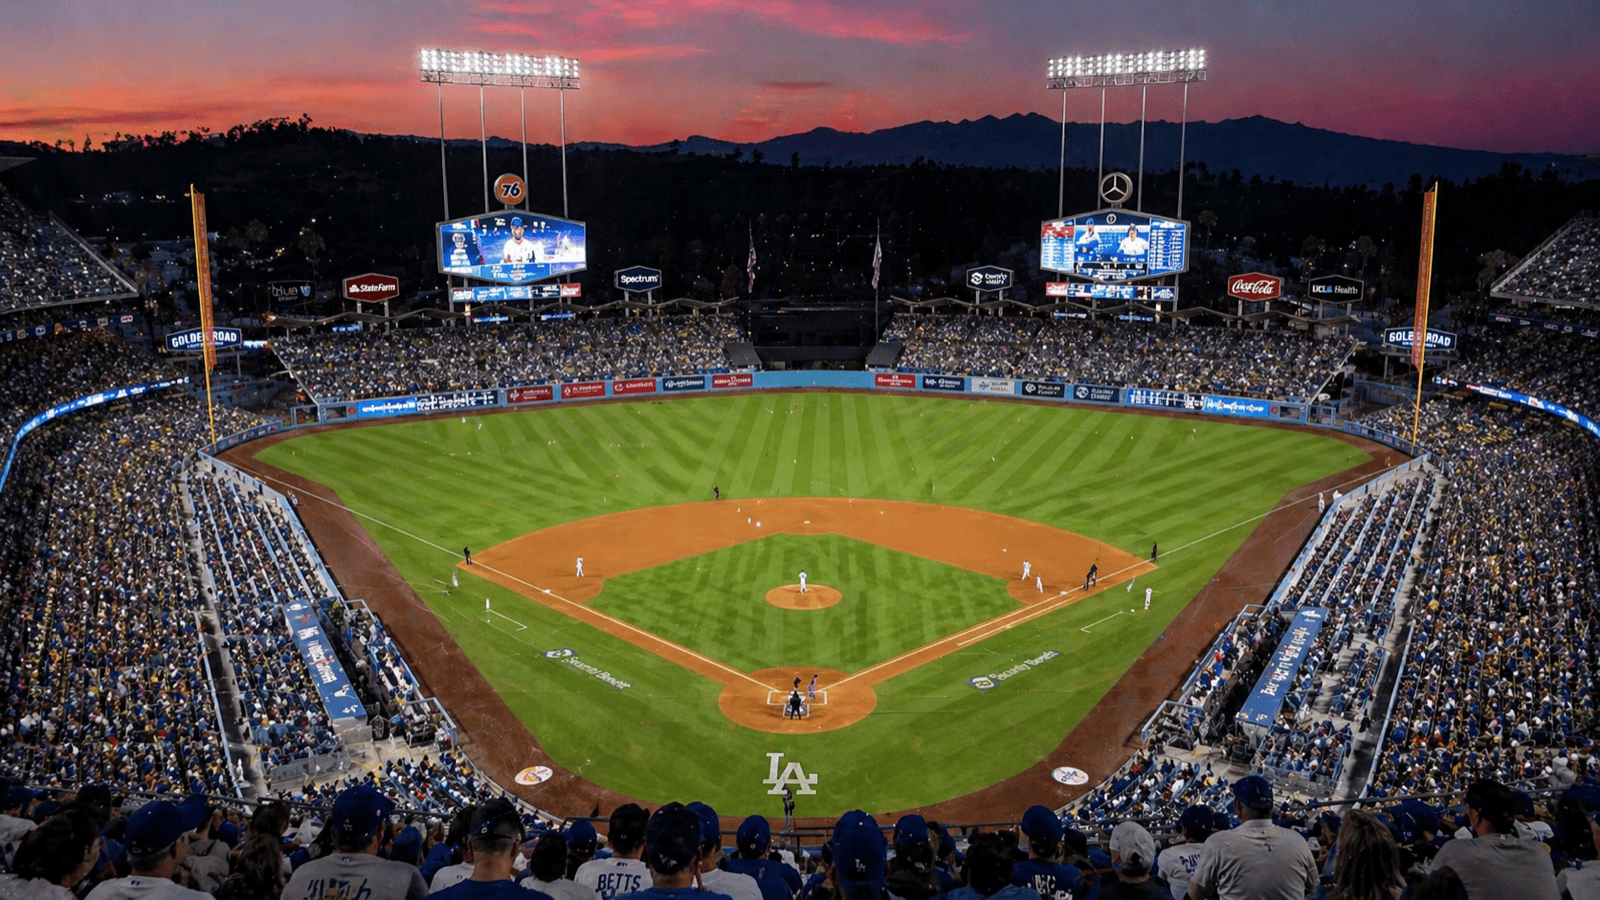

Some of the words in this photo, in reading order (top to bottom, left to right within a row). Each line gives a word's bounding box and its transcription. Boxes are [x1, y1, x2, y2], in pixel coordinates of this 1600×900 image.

[501, 182, 522, 198] 76
[620, 274, 658, 285] Spectrum
[1312, 284, 1333, 293] UCLA
[1334, 284, 1358, 294] Health
[213, 330, 238, 343] ROAD
[1426, 332, 1452, 347] ROAD
[763, 752, 818, 795] LA
[597, 873, 642, 893] BETTS
